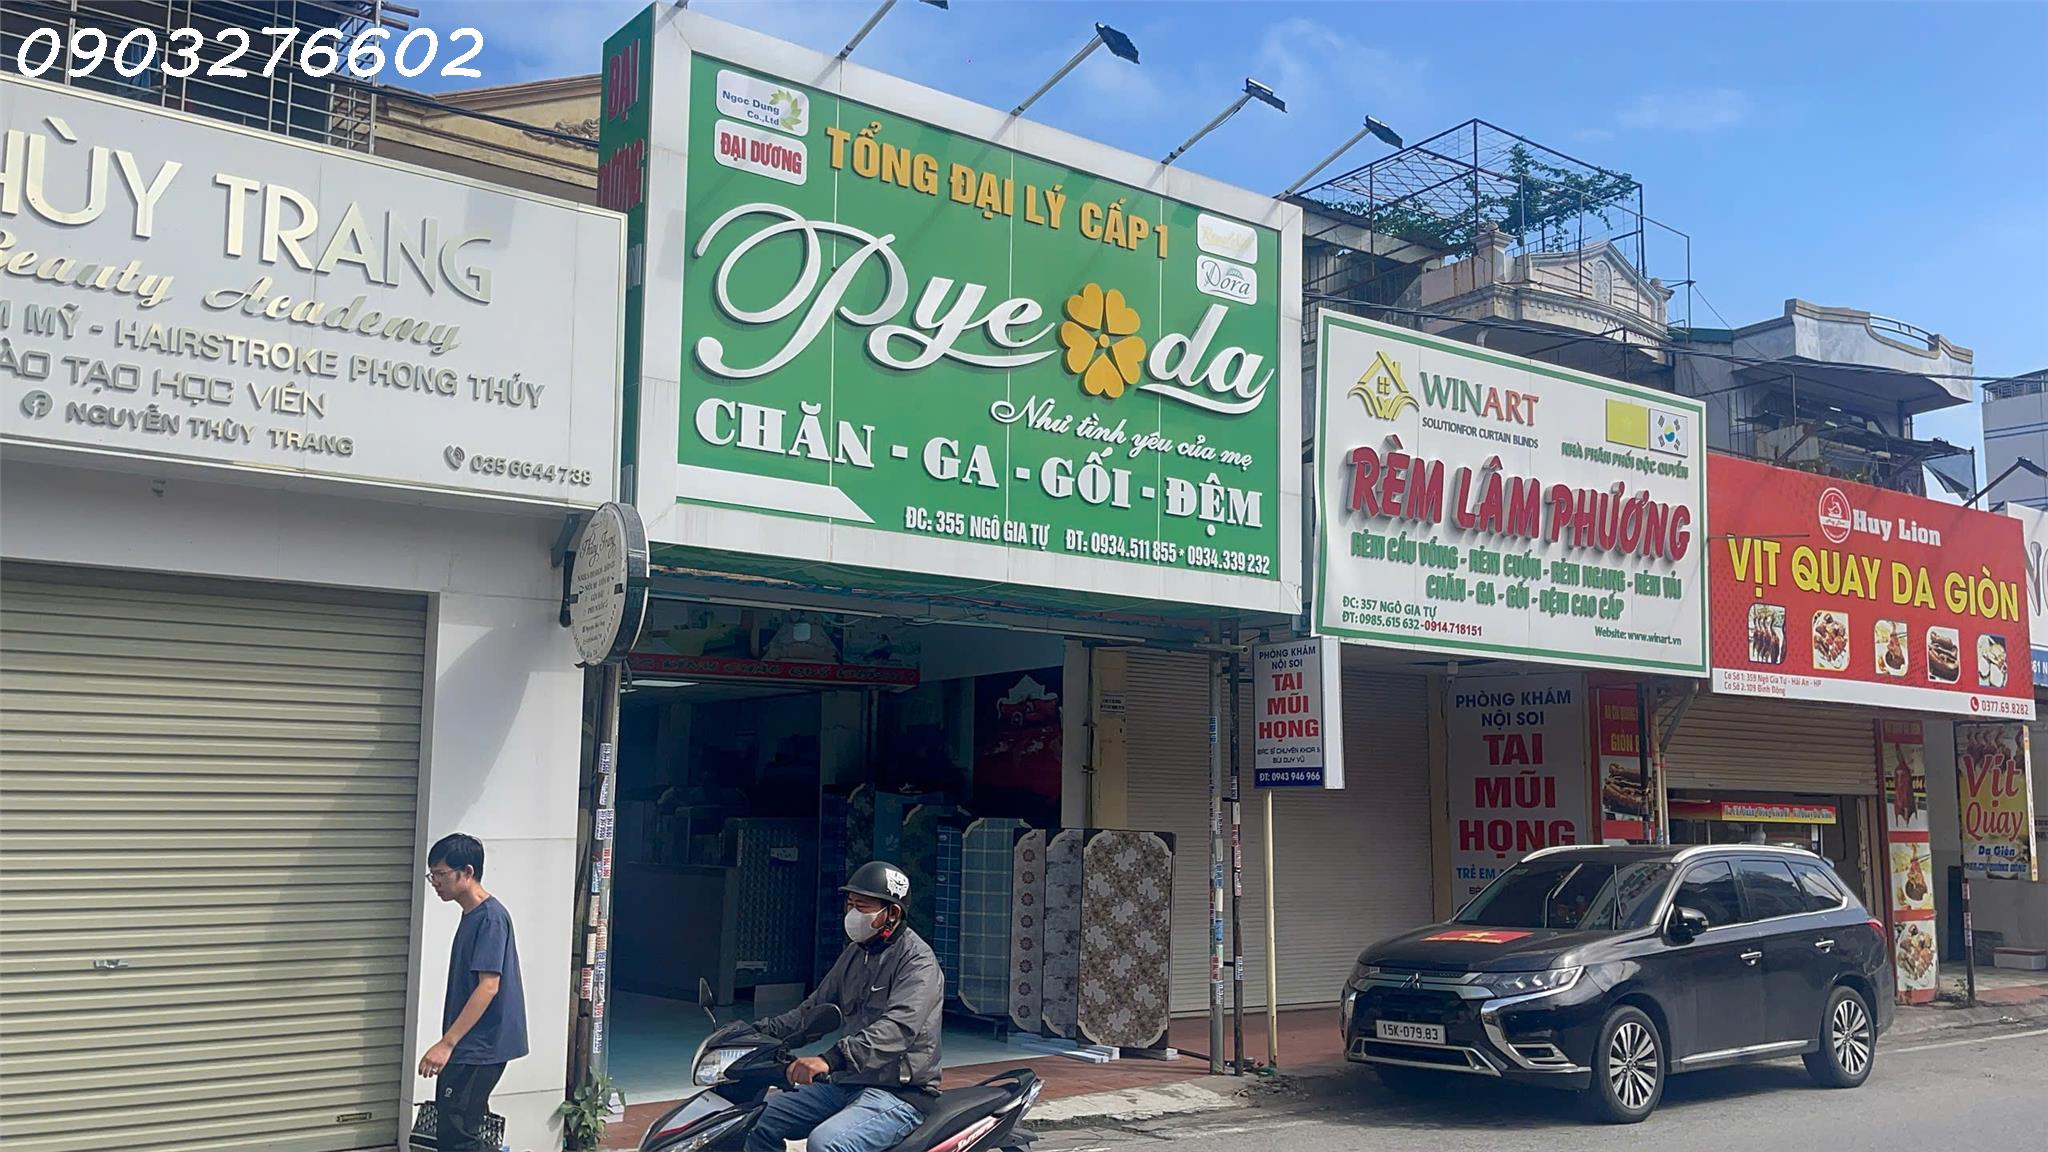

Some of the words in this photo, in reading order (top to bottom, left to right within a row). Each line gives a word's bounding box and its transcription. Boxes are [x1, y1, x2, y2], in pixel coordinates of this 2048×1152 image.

[722, 90, 750, 105] Ngoc
[752, 99, 780, 116] Dung
[720, 131, 747, 162] ĐẠI
[751, 139, 802, 175] DƯƠNG
[825, 121, 939, 197] TỔNG
[949, 162, 1014, 219] ĐẠI
[1024, 184, 1067, 230] LÝ
[212, 173, 492, 306] TRANG
[695, 202, 1058, 379] Pye
[1201, 260, 1251, 296] Dora
[200, 275, 461, 357] Academy
[25, 303, 82, 338] MỸ
[115, 318, 339, 376] HAIRSTROKE
[350, 354, 460, 397] PHONG
[62, 355, 142, 396] TẠO
[152, 368, 235, 407] HỌC
[247, 381, 326, 419] VIÊN
[1419, 371, 1540, 428] WINART
[65, 402, 181, 433] NGUYỄN
[187, 417, 256, 444] THÙY
[269, 427, 354, 456] TRANG
[989, 395, 1074, 435] Như
[1075, 413, 1129, 445] tình
[1127, 432, 1174, 459] yêu
[1177, 435, 1217, 461] của
[1219, 449, 1254, 472] mẹ
[1478, 428, 1512, 445] CURTAIN
[1512, 435, 1539, 449] BLINDS
[694, 397, 876, 470] CHĂN
[923, 436, 1000, 489] GA
[1041, 447, 1133, 509] GỐI
[1165, 472, 1264, 538] ĐỆM
[1561, 441, 1584, 460] NHÀ
[1346, 434, 1445, 525] RÈM
[1454, 455, 1540, 540] LÂM
[1546, 480, 1691, 562] PHƯƠNG
[905, 506, 933, 531] ĐC:
[935, 513, 966, 537] 355
[969, 513, 1000, 542] NGÔ
[1003, 521, 1028, 545] GIA
[1030, 523, 1051, 551] TỰ
[1852, 509, 1892, 543] Huy
[1899, 518, 1942, 548] Lion
[1065, 529, 1088, 552] ĐT:
[1091, 532, 1151, 561] 0934.511
[1152, 541, 1177, 563] 855
[1187, 548, 1246, 573] 0934.339
[1247, 553, 1271, 575] 232
[1350, 528, 1386, 560] RÈM
[1387, 531, 1417, 564] CẦU
[1418, 536, 1459, 570] VỒNG
[1469, 545, 1501, 576] RÈM
[1503, 549, 1542, 581] CUỐN
[1551, 558, 1581, 587] RÈM
[1582, 565, 1627, 593] NGANG
[1634, 569, 1661, 597] RÈM
[1425, 572, 1467, 602] CHĂN
[1475, 580, 1496, 606] GA
[1506, 579, 1530, 610] GỐI
[1539, 586, 1570, 618] ĐỆM
[1571, 593, 1598, 618] CAO
[1599, 591, 1625, 621] CẤP
[1726, 533, 1782, 599] VỊT
[1791, 545, 1882, 601] QUAY
[1891, 561, 1937, 610] DA
[1944, 563, 2020, 624] GIÒN
[1342, 595, 1360, 610] ĐC:
[1360, 598, 1378, 612] 357
[1379, 598, 1402, 615] NGÔ
[1404, 604, 1422, 617] GIA
[1423, 605, 1438, 621] TỰ
[1342, 610, 1359, 624] ĐT:
[1359, 613, 1401, 629] 0985.615
[1259, 649, 1289, 661] PHÒNG
[1291, 645, 1316, 658] KHÁM
[1594, 625, 1627, 640] Website:
[1627, 631, 1682, 647] www.winart.vn
[1271, 659, 1287, 672] NỘI
[1289, 658, 1303, 669] SOI
[1272, 671, 1303, 692] TAI
[1267, 692, 1310, 716] MŨI
[1455, 689, 1516, 709] PHÒNG
[1520, 686, 1572, 707] KHÁM
[1981, 700, 2030, 716] 0377.69.8282
[1258, 718, 1320, 743] HỌNG
[1481, 709, 1512, 731] NỘI
[1516, 711, 1545, 727] SOI
[1483, 733, 1544, 766] TAI
[1259, 772, 1271, 782] ĐT:
[1271, 772, 1290, 782] 0943
[1291, 772, 1305, 782] 946
[1306, 771, 1321, 781] 966
[1474, 769, 1557, 809] MŨI
[1962, 753, 2022, 808] Vịt
[1459, 819, 1576, 859] HỌNG
[1965, 801, 2024, 843] Quay
[1978, 845, 1991, 856] Da
[1456, 863, 1477, 880] TRẺ
[1479, 867, 1497, 880] EM
[1382, 1023, 1439, 1041] 15K-079.83
